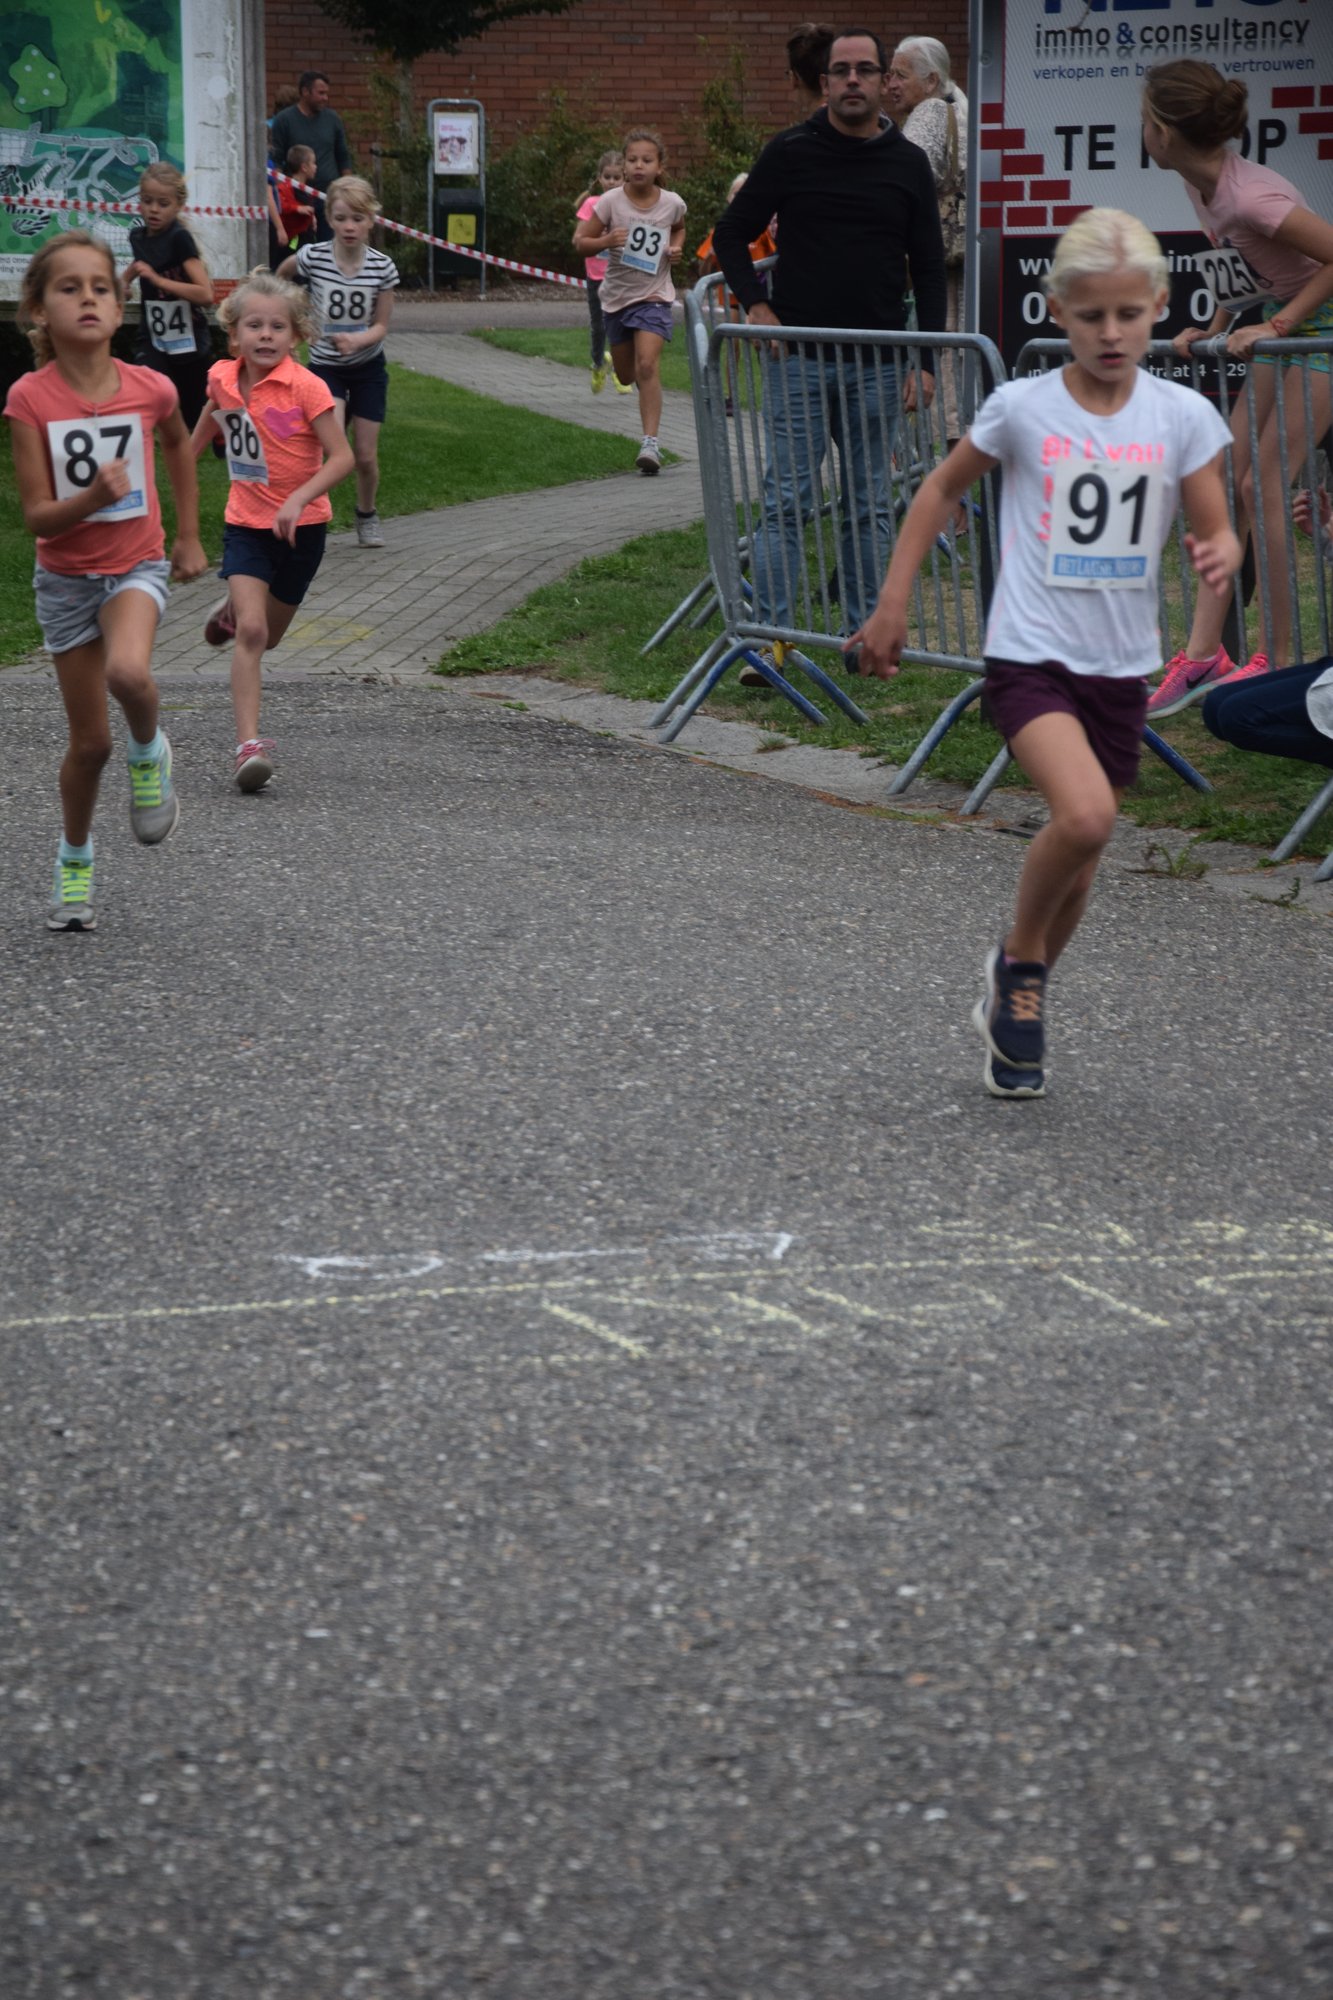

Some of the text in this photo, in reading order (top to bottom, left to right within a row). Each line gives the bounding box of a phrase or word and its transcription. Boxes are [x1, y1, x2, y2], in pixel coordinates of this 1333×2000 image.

[1035, 23, 1111, 48] immo
[1140, 17, 1311, 44] consultancy
[1033, 63, 1105, 80] verkopen
[1110, 64, 1130, 78] en
[1223, 57, 1315, 74] vertrouwen
[1055, 124, 1116, 171] TE
[630, 226, 661, 256] 93
[1204, 256, 1257, 301] 225
[151, 304, 187, 337] 84
[328, 289, 367, 321] 88
[63, 424, 133, 488] 87
[224, 413, 260, 460] 86
[1067, 472, 1149, 545] 91
